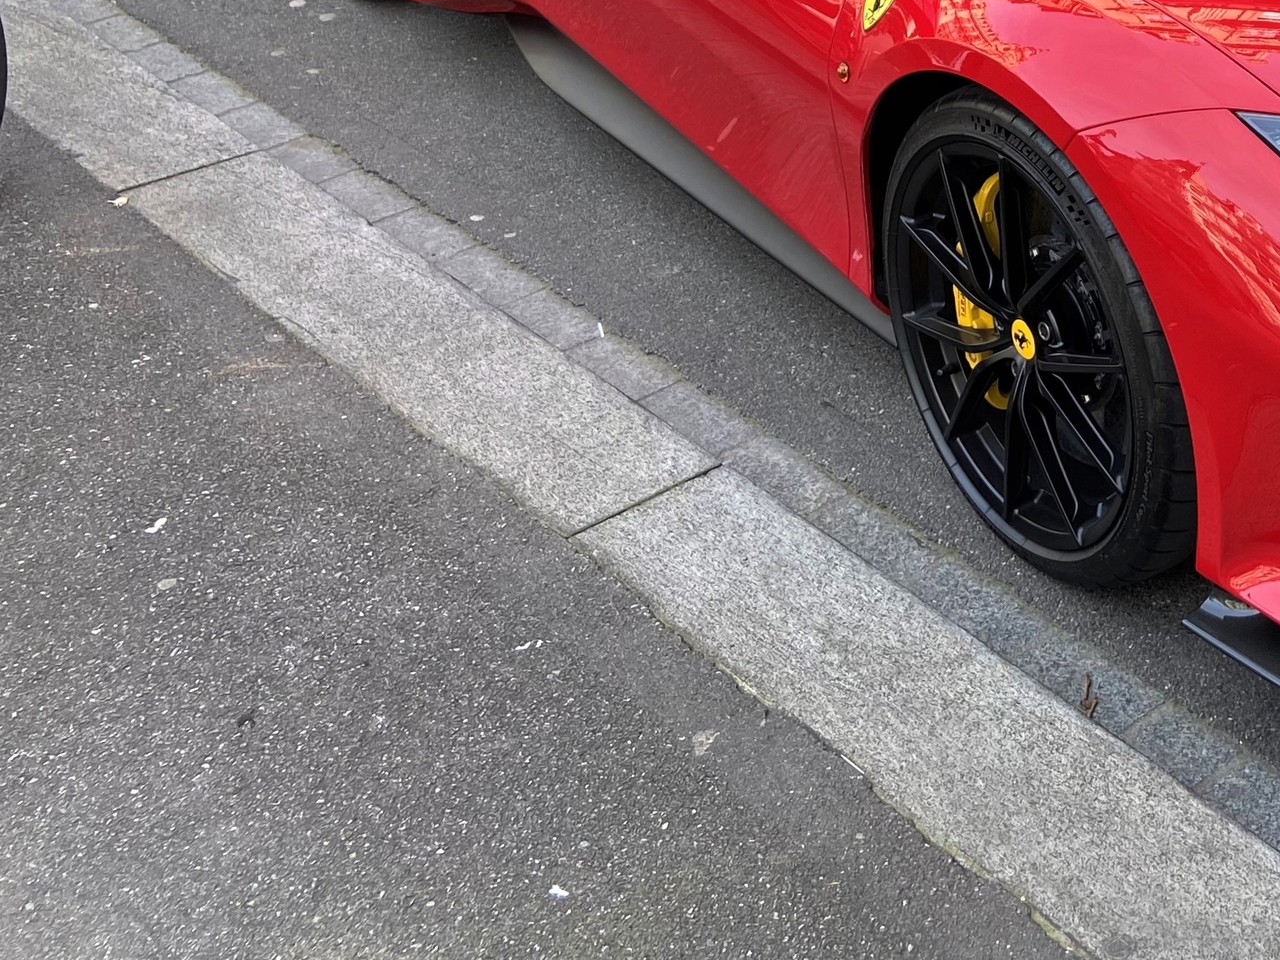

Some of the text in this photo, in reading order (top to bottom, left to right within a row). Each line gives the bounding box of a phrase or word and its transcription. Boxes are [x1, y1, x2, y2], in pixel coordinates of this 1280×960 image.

[1007, 134, 1065, 193] MICHELIN
[1145, 430, 1155, 466] Pilot
[1142, 465, 1153, 502] Sport
